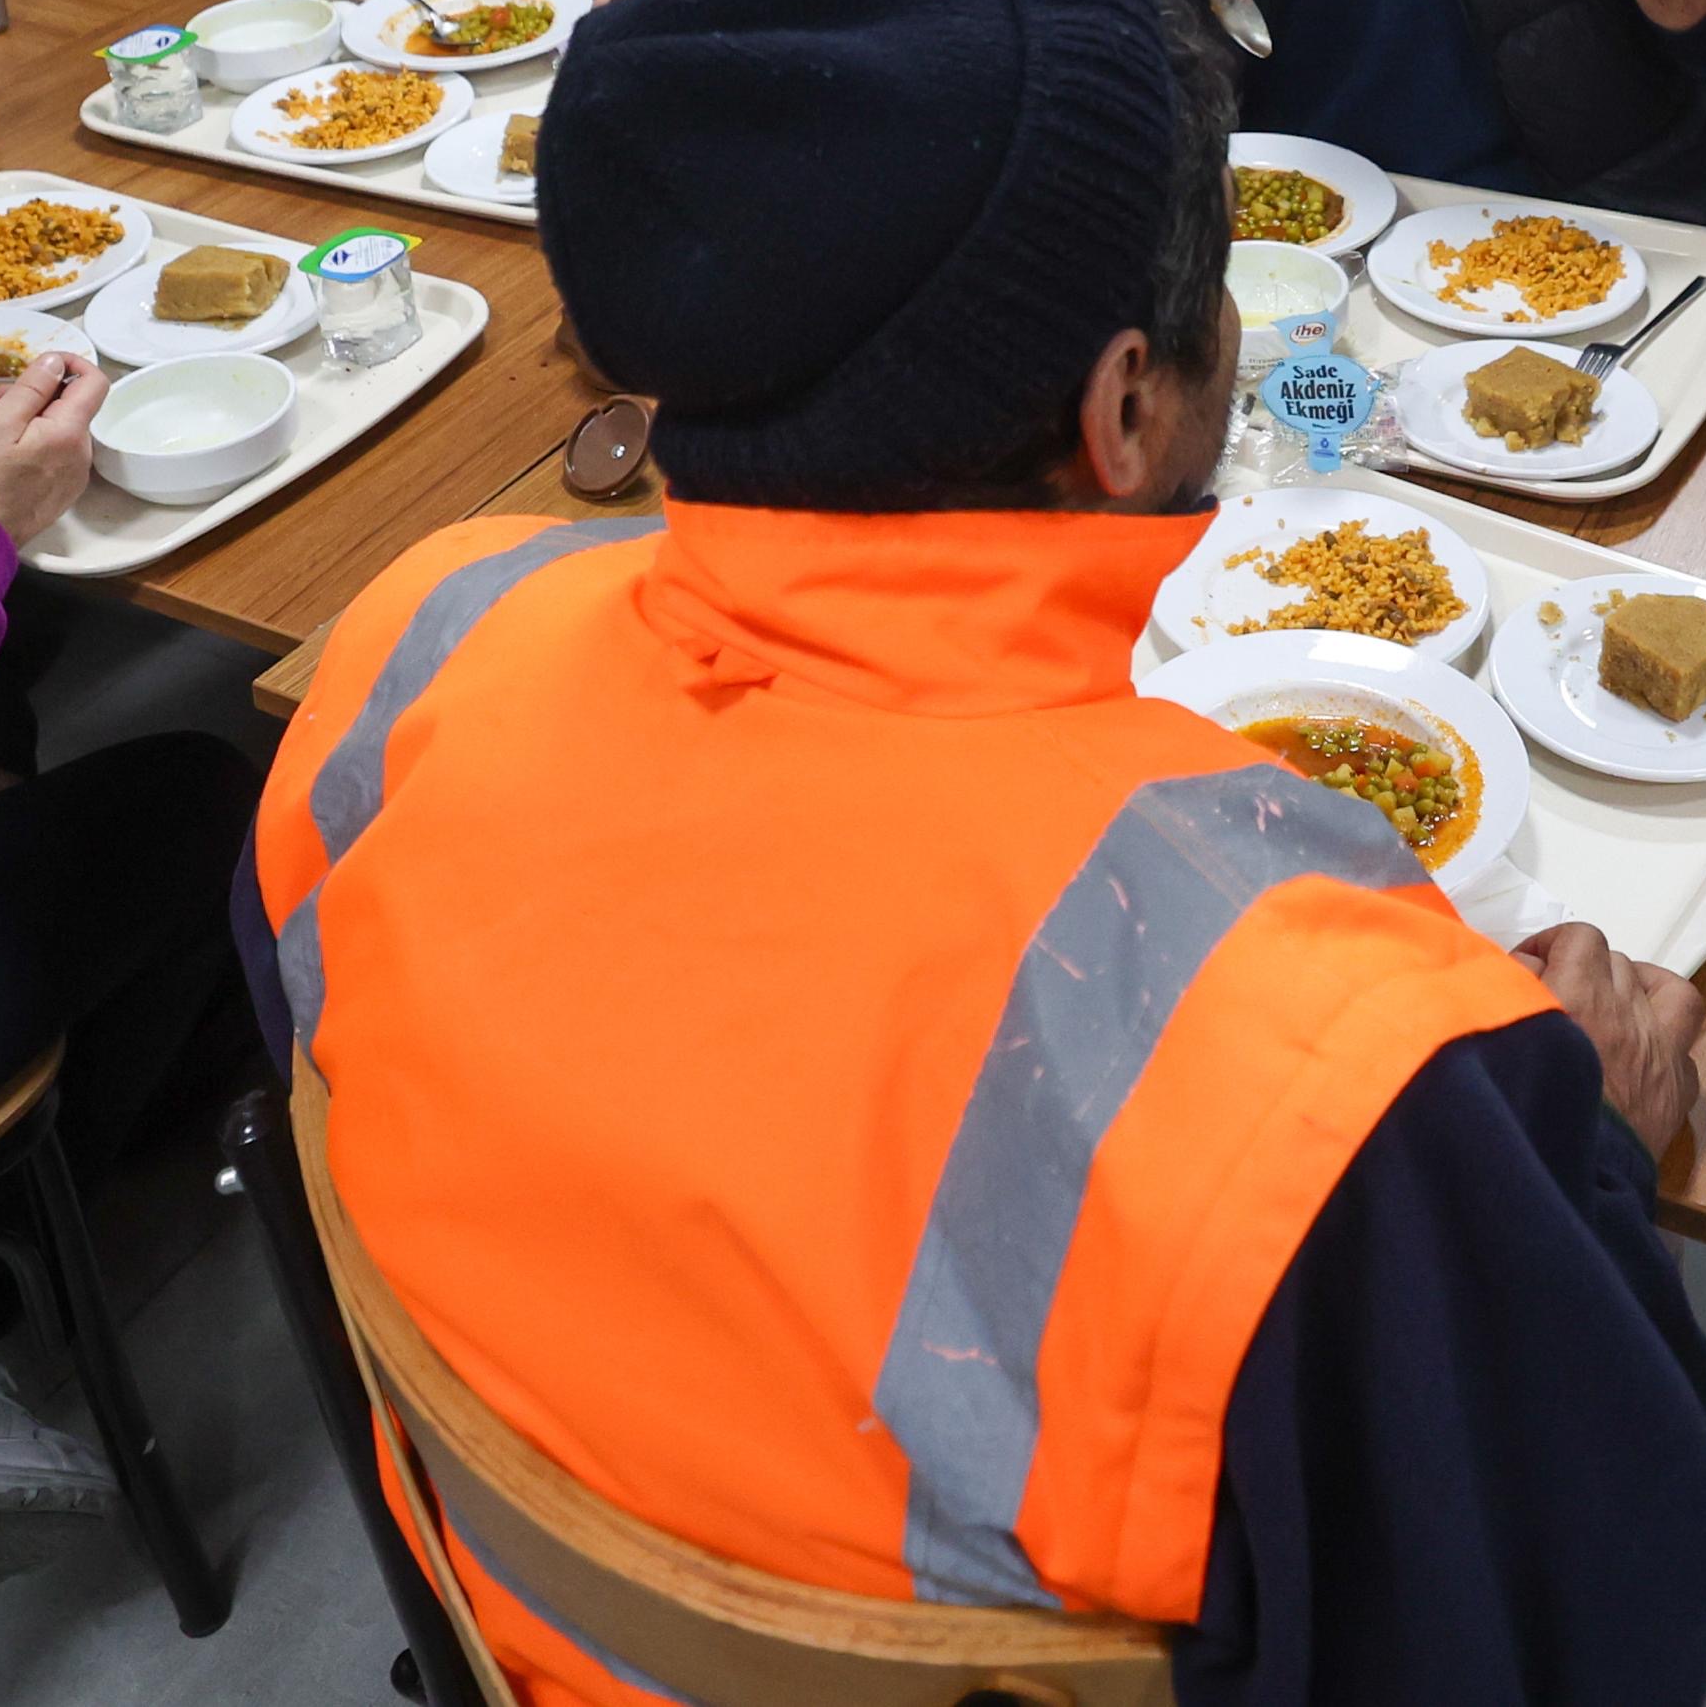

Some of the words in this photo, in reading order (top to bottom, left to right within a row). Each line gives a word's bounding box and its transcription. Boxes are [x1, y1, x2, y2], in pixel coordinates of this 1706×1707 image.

[1293, 365, 1338, 379] Sade
[1280, 379, 1356, 399] Akdeniz
[1285, 400, 1355, 424] Ekmeği
